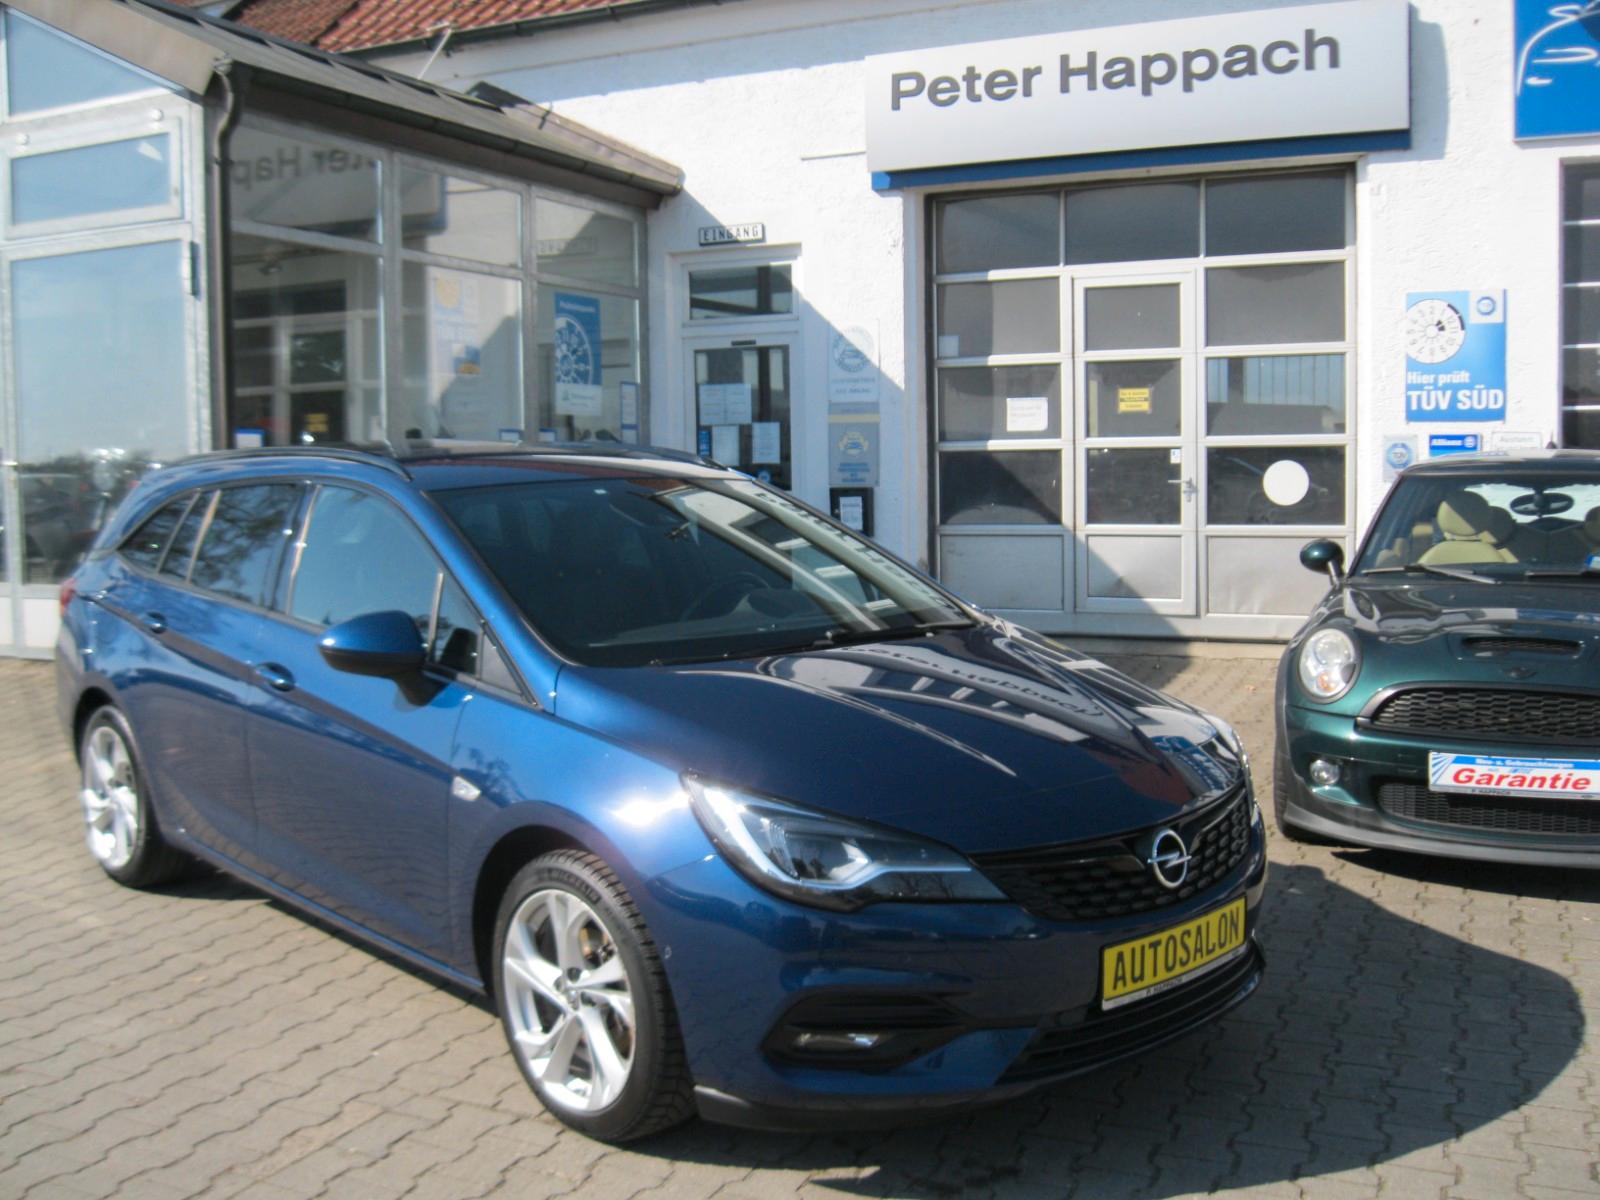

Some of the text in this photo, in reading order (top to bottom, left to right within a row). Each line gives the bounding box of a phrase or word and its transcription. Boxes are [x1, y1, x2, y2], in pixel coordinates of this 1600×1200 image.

[891, 28, 1340, 111] Peter Happach
[703, 225, 759, 241] EINGANG
[1407, 370, 1470, 387] Hier prüft
[1406, 384, 1504, 411] TÜV SÜD
[1452, 767, 1592, 790] Garantie
[1112, 906, 1240, 991] AUTOSALON
